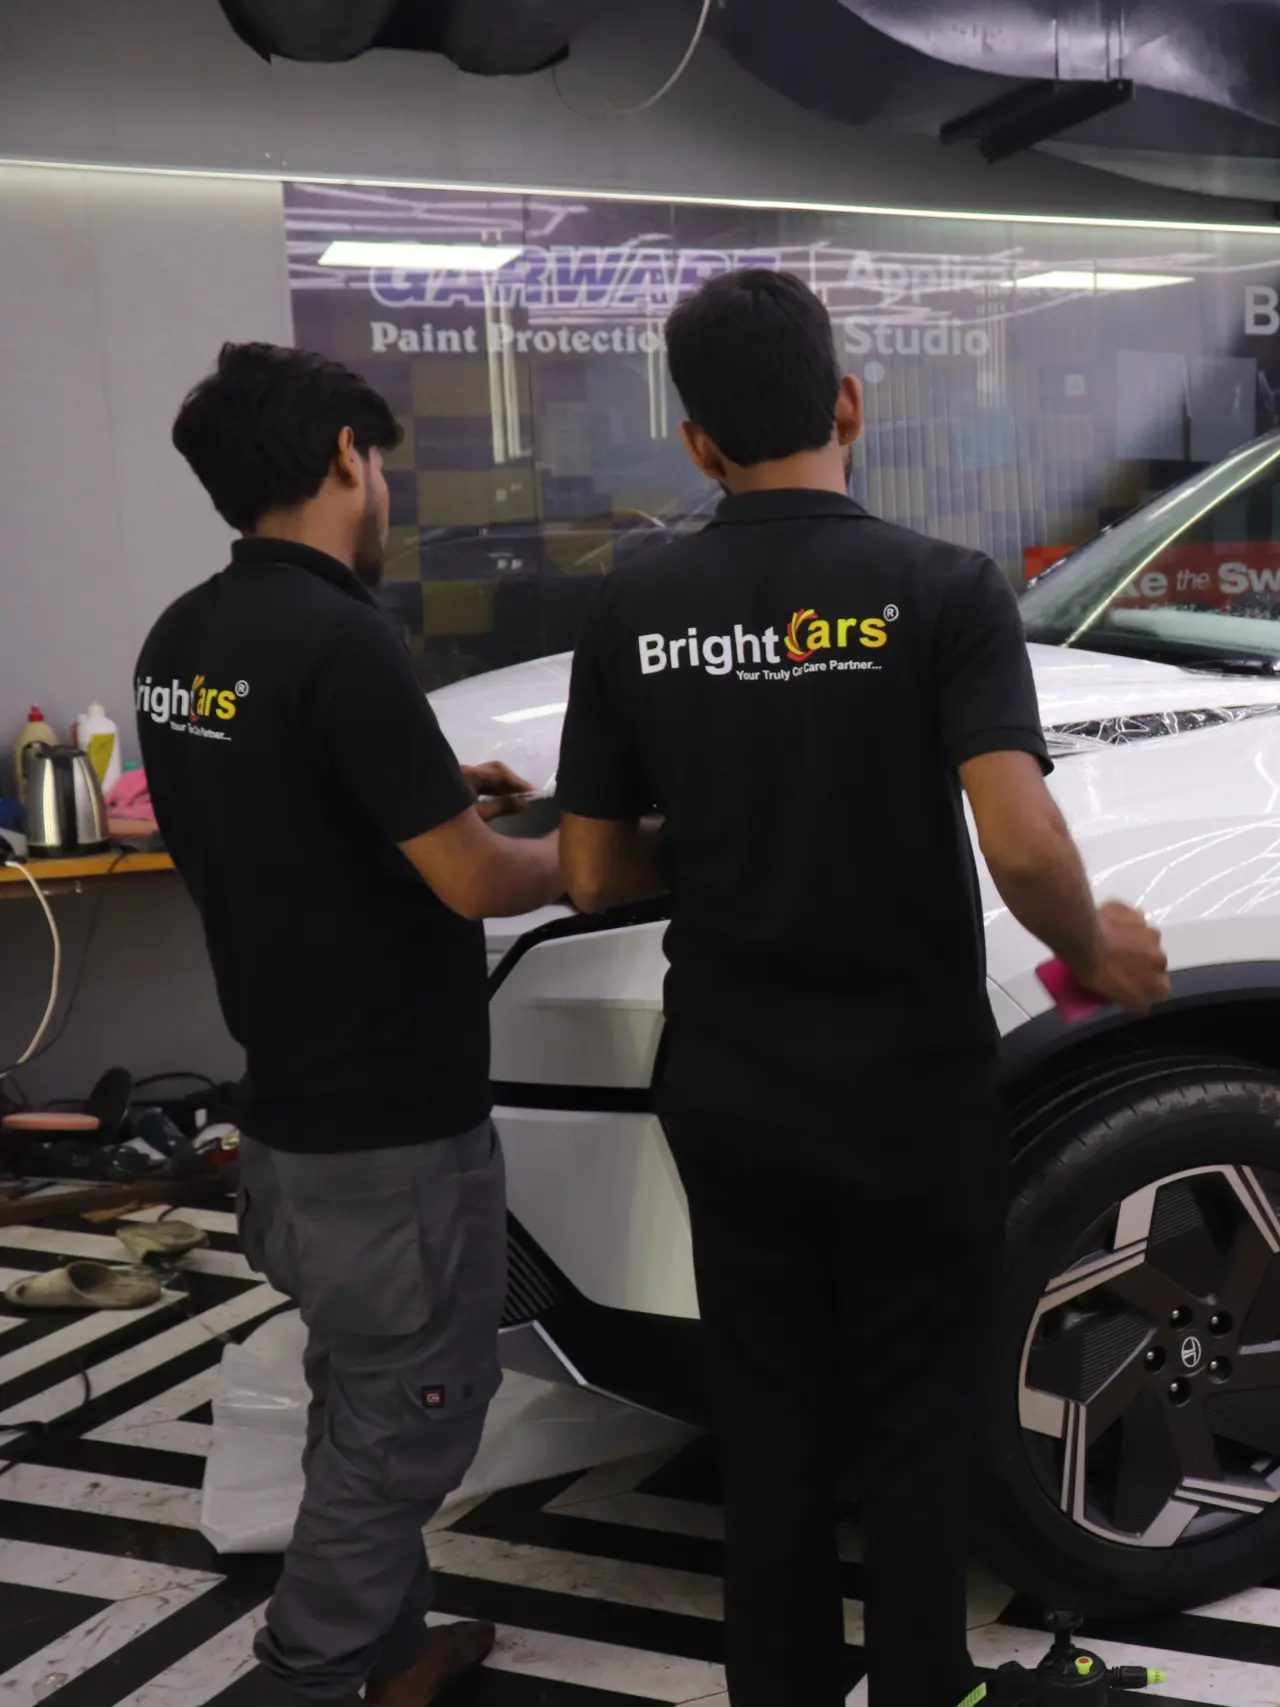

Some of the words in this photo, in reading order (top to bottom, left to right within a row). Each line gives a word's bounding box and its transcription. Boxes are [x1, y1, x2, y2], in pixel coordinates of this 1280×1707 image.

[370, 321, 478, 353] Paint
[493, 321, 669, 353] Protectio
[843, 315, 990, 356] Studio
[1176, 569, 1210, 591] the
[736, 670, 760, 680] Your
[762, 669, 790, 681] Truly
[803, 662, 827, 673] Care
